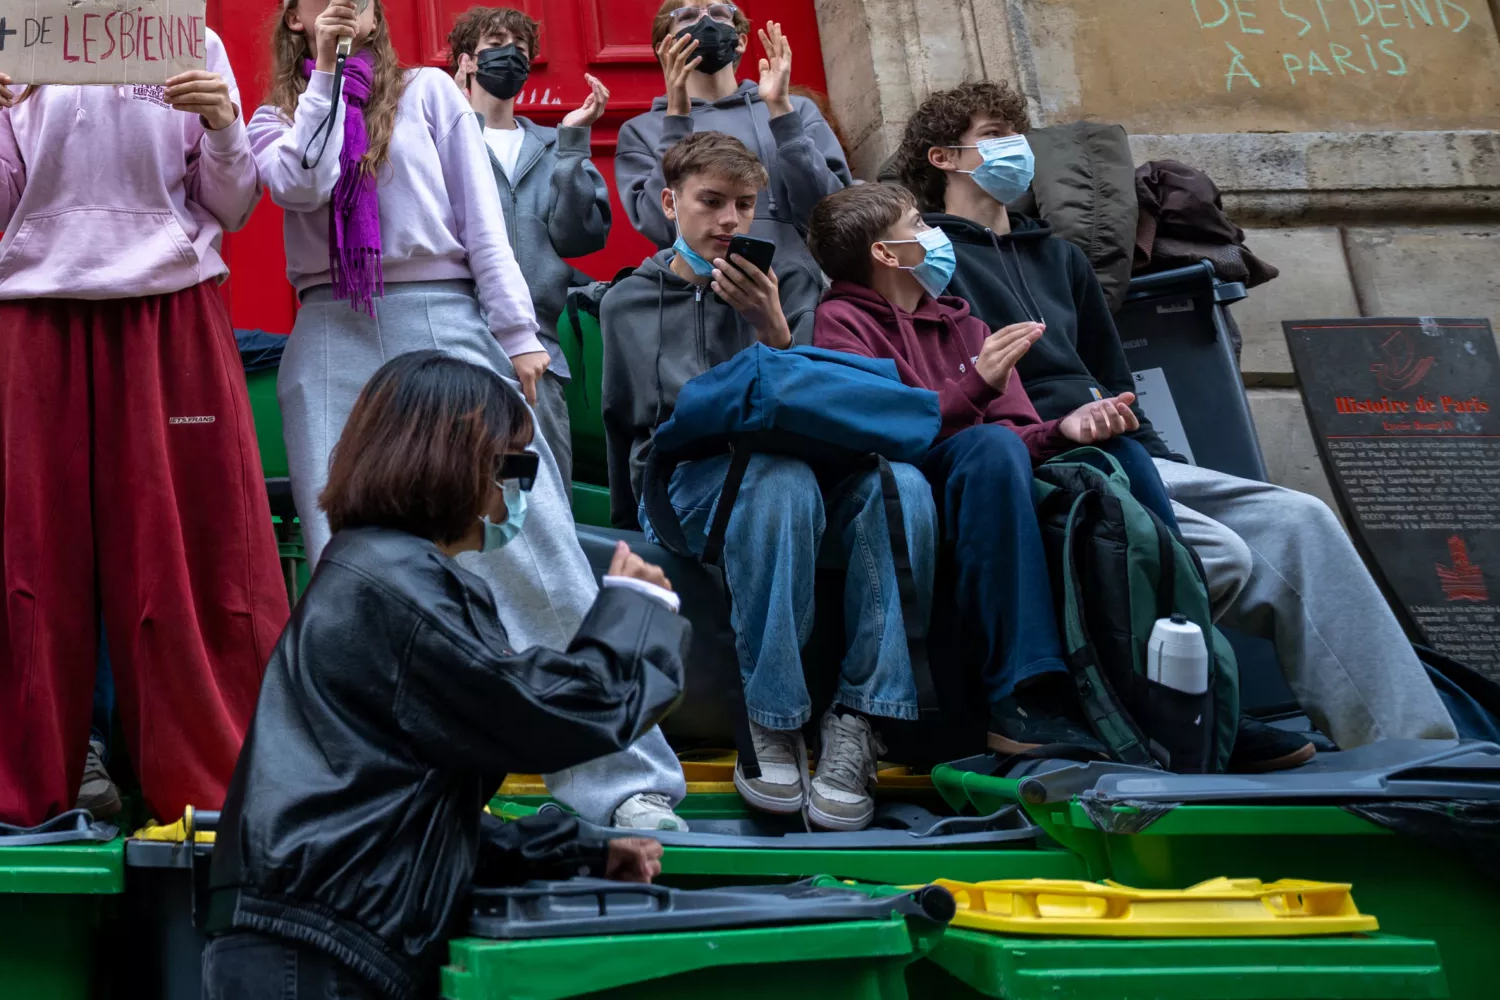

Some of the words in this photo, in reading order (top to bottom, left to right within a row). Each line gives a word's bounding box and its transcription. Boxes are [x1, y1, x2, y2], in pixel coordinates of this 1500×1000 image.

[23, 16, 53, 48] DE
[1335, 395, 1410, 414] Histoire
[1415, 395, 1437, 414] de
[1440, 395, 1490, 414] Paris
